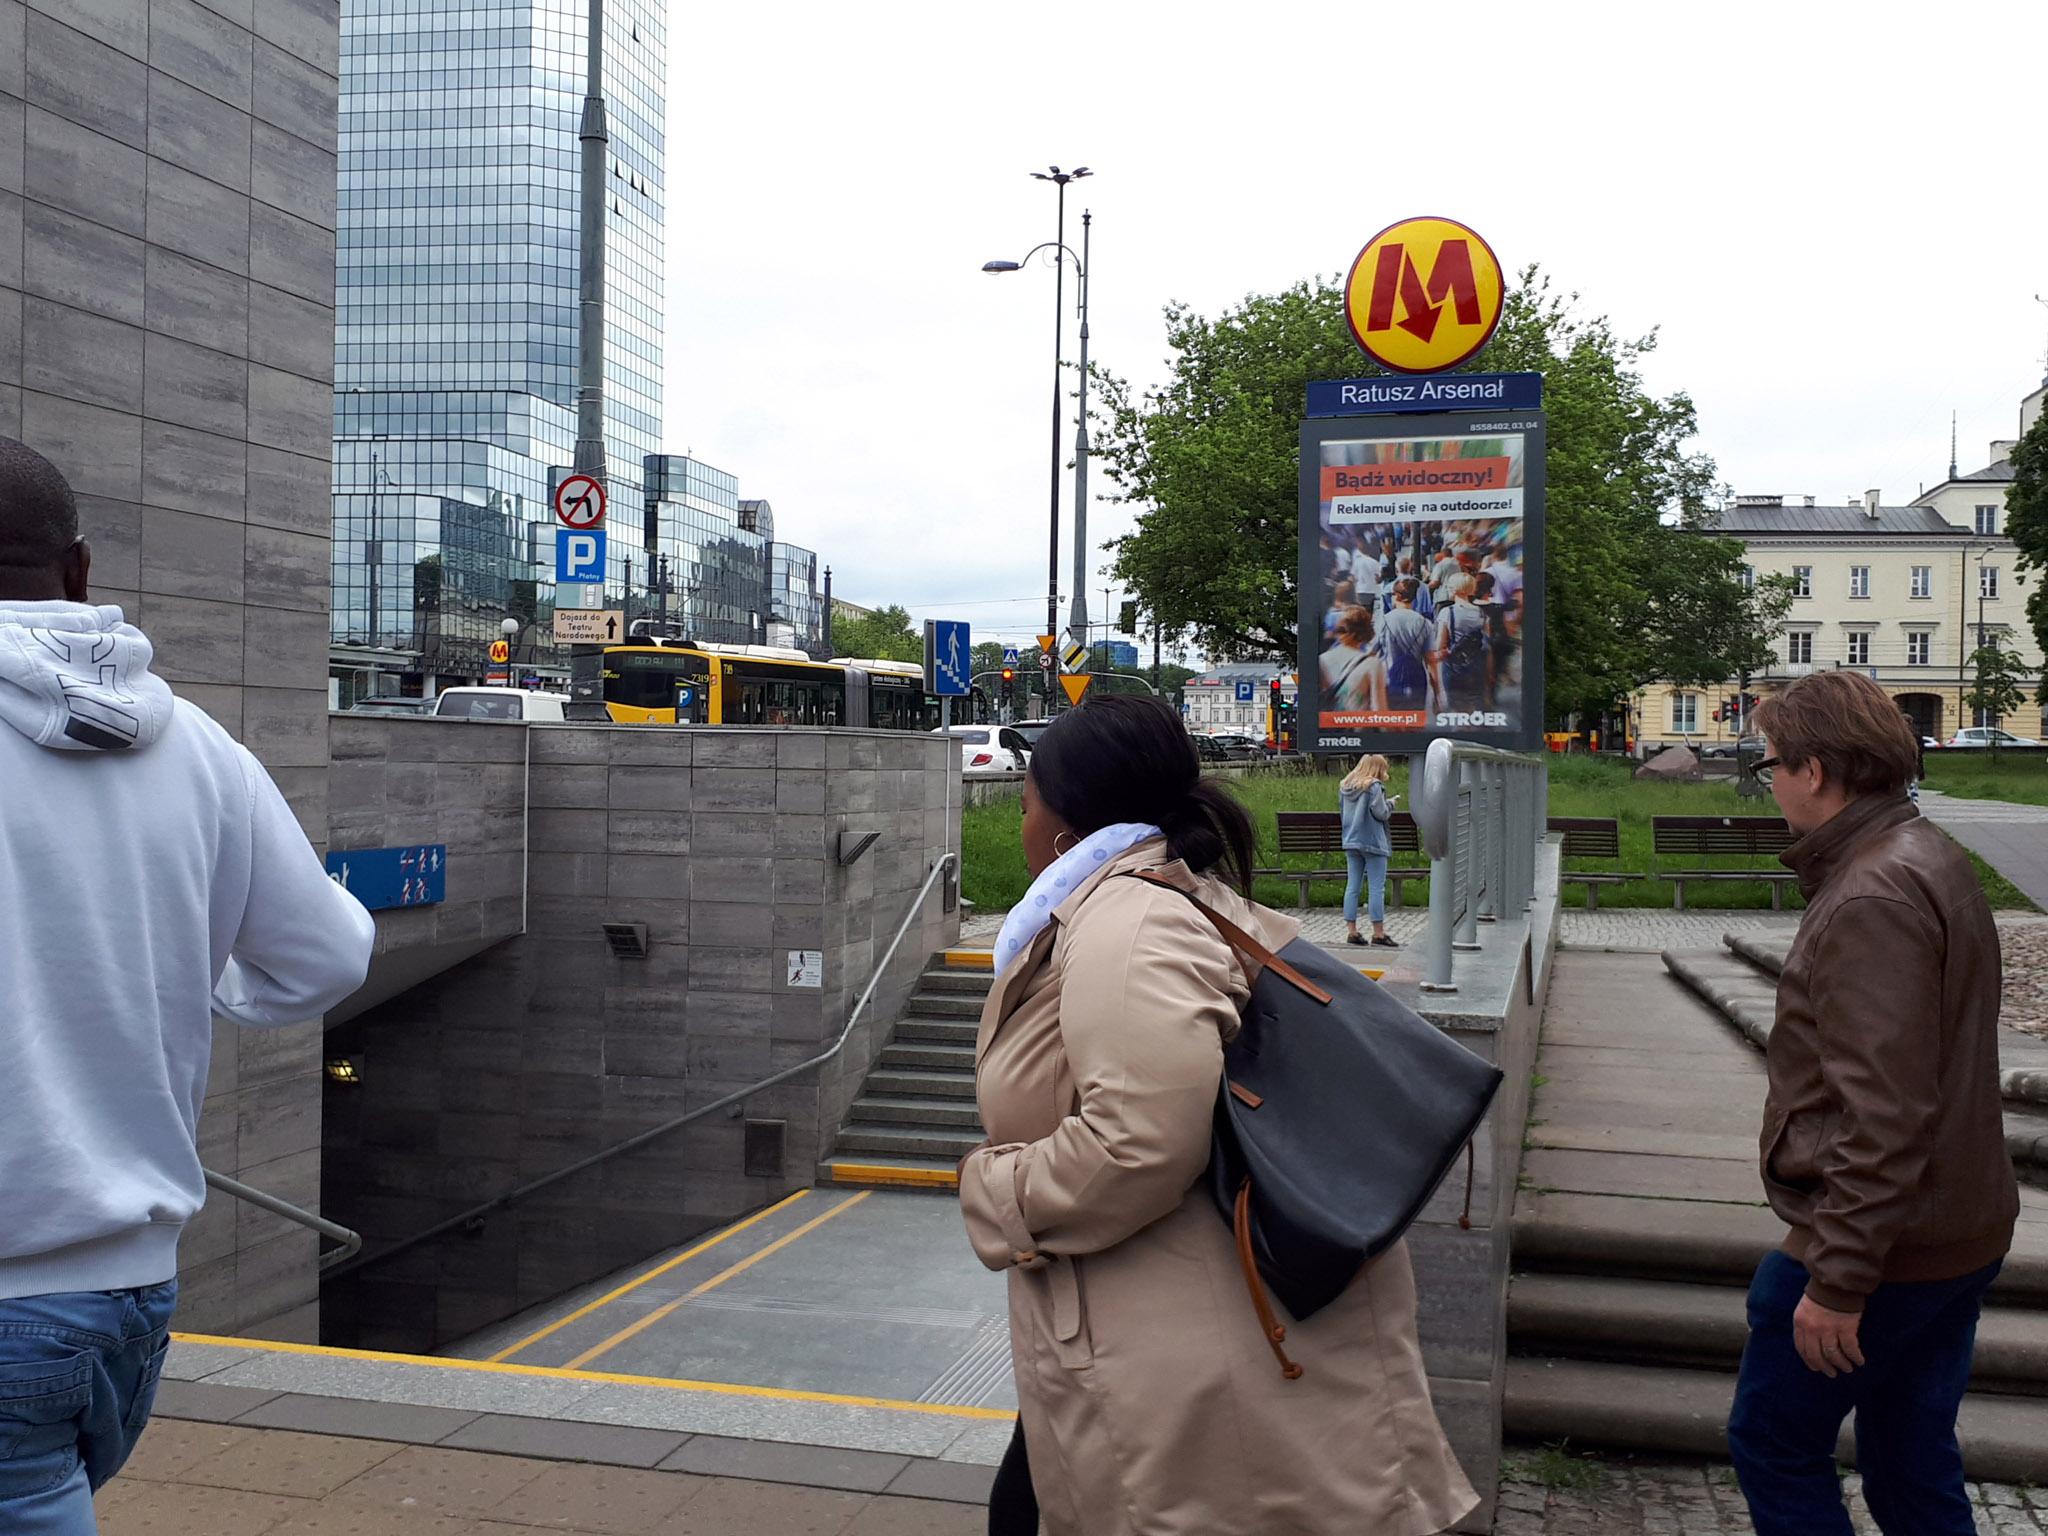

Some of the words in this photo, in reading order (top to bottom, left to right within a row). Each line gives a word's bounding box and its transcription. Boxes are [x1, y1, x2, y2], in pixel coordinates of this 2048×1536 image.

[1341, 386, 1415, 404] Ratusz
[1419, 379, 1504, 400] Arsenał
[1335, 471, 1384, 491] Bądź
[1389, 467, 1493, 490] widoczny!
[1337, 502, 1396, 515] Reklamuj
[1398, 502, 1416, 514] się
[1422, 502, 1437, 512] na
[1440, 498, 1513, 512] outdoorze!
[567, 536, 596, 576] P
[560, 613, 588, 622] Dojazd
[590, 613, 601, 621] do
[568, 623, 593, 631] Teatru
[555, 632, 606, 641] Narodowego
[679, 690, 689, 705] P
[1334, 714, 1417, 724] www.stroer.pl
